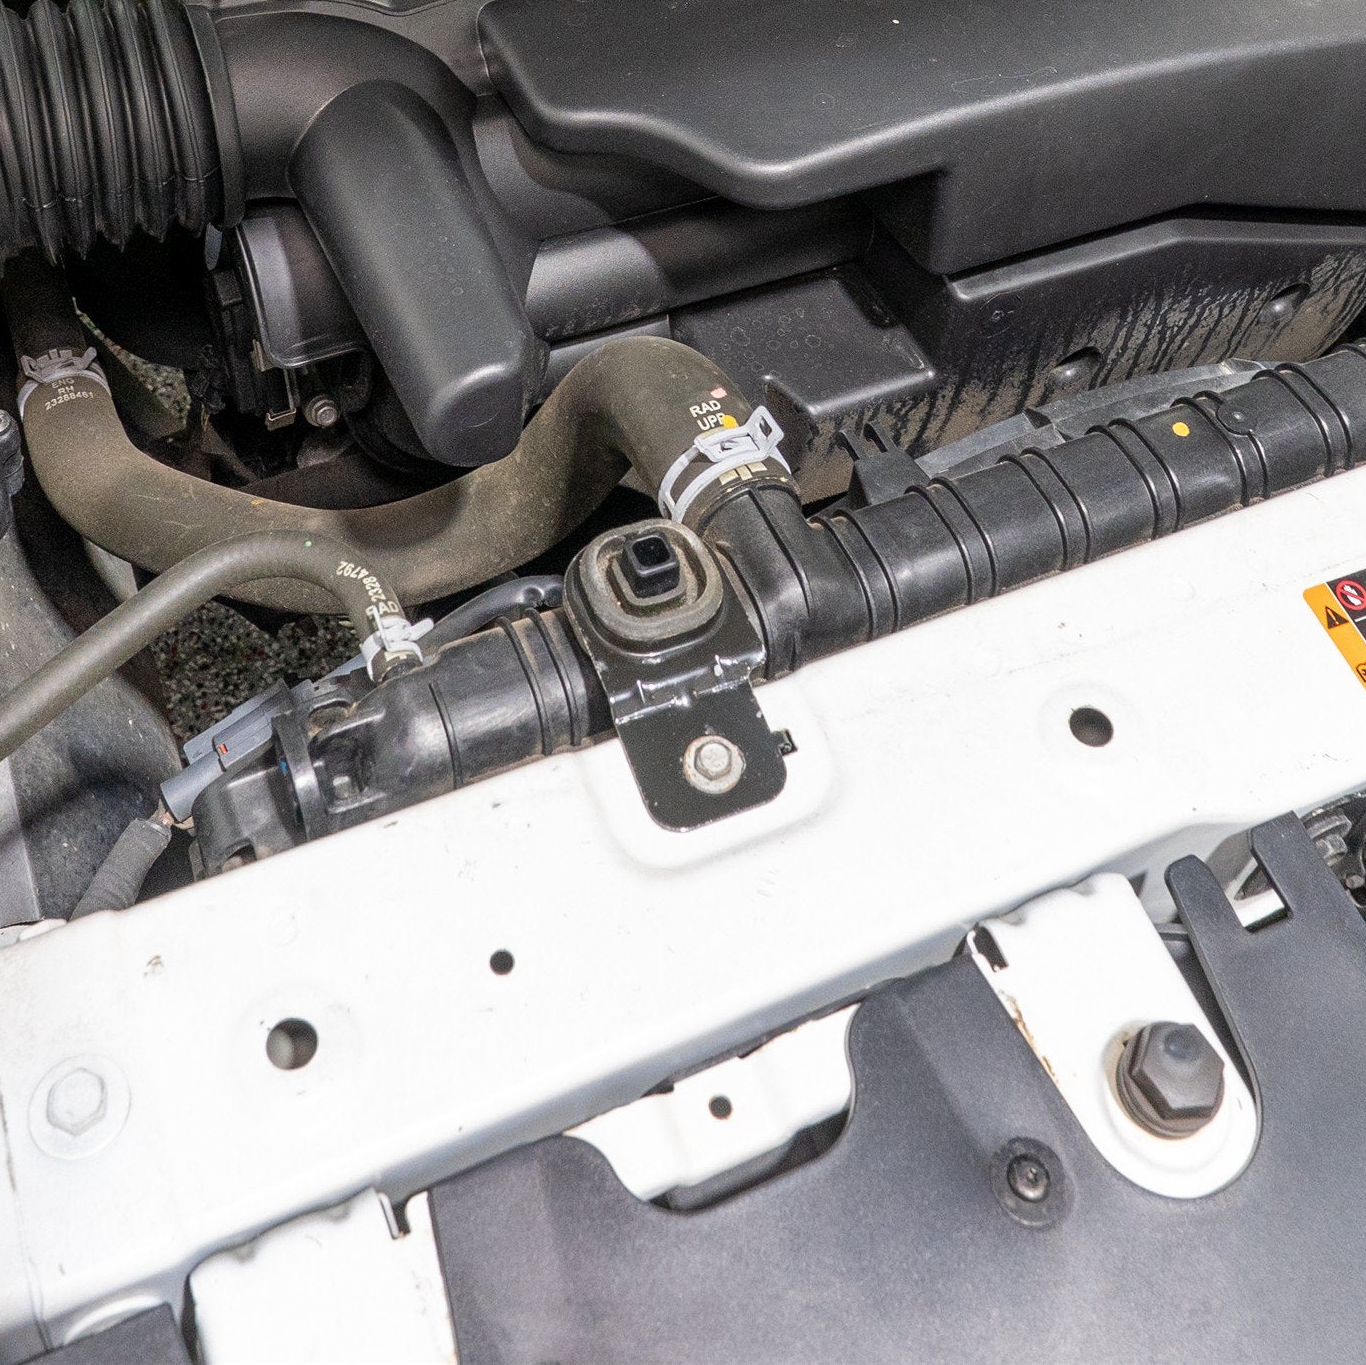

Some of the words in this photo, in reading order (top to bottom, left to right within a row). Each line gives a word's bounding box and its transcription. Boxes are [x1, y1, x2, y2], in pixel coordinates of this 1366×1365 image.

[51, 377, 75, 389] ENG
[57, 385, 74, 395] RH
[689, 400, 721, 418] RAD
